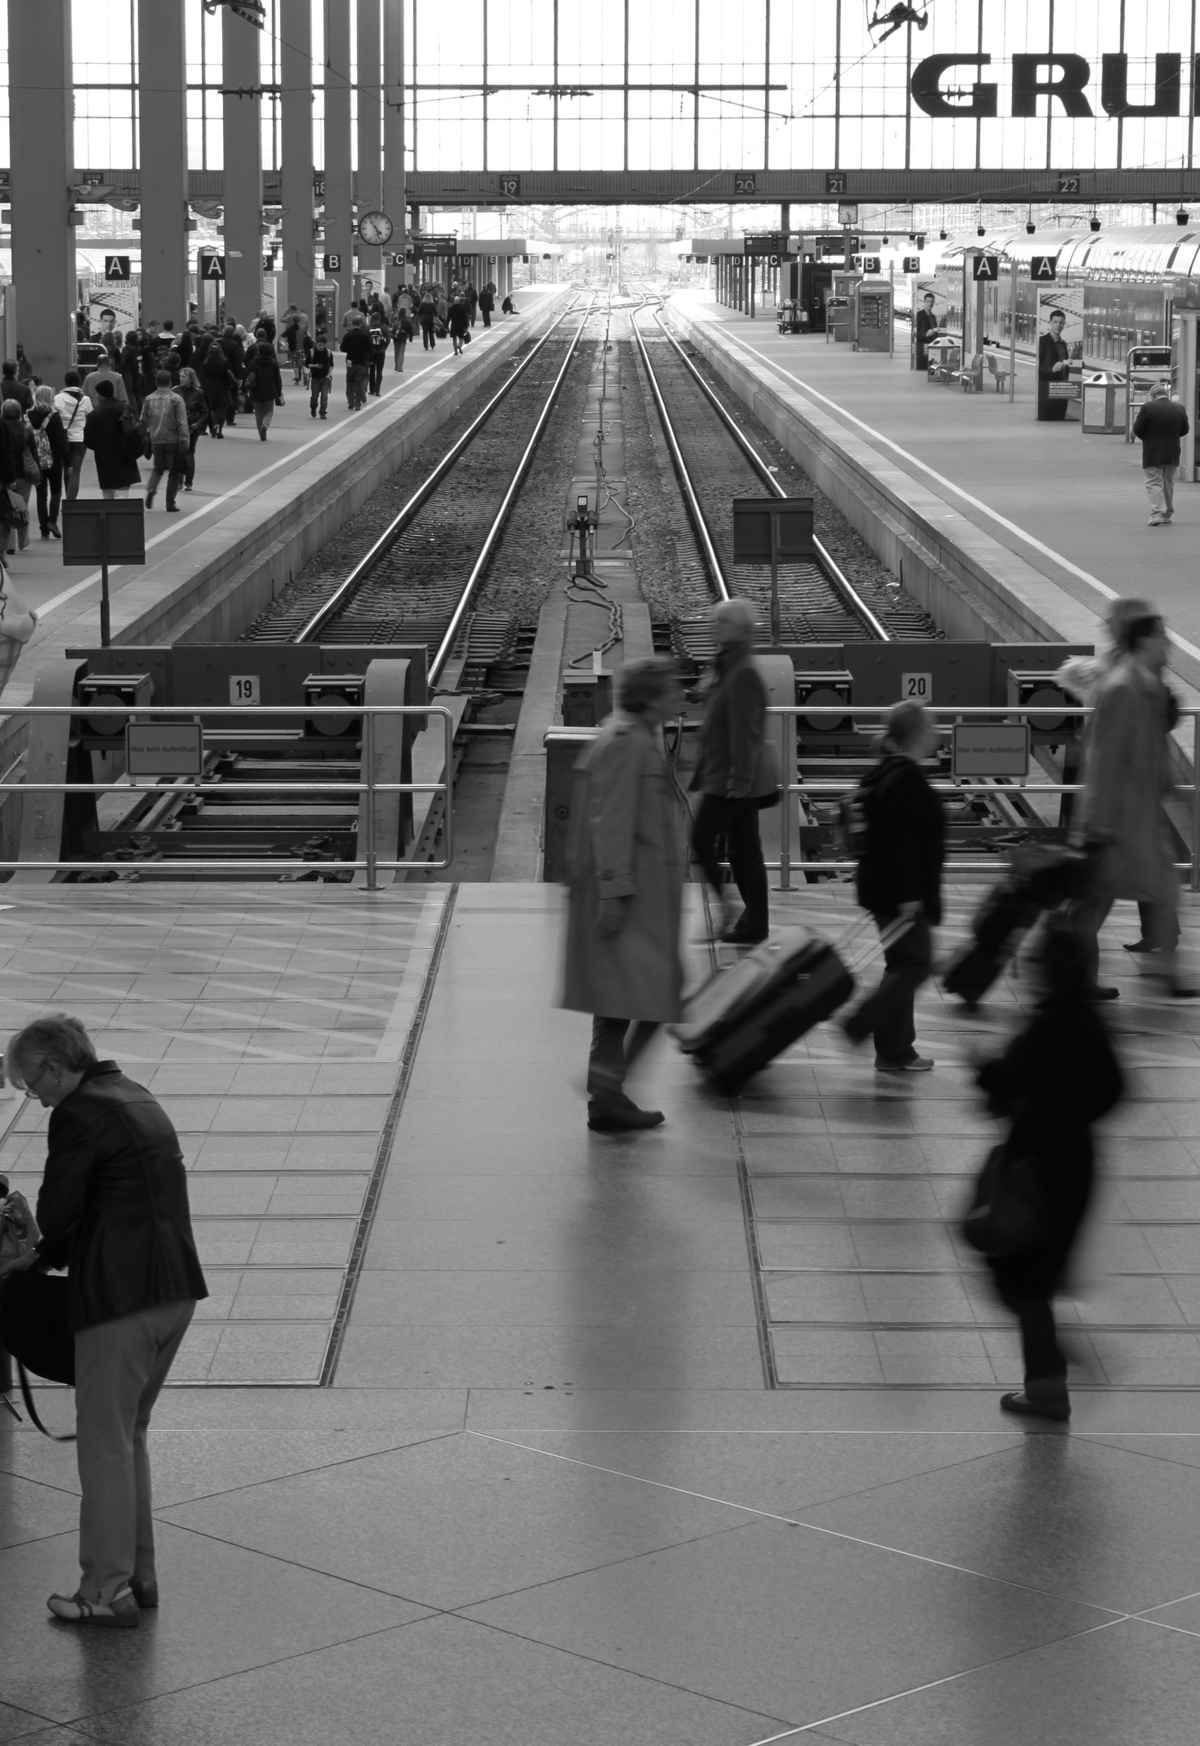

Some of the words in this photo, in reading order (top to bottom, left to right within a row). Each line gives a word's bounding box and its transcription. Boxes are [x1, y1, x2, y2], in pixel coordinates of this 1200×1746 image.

[911, 53, 1200, 117] GRU
[503, 181, 517, 193] 19
[736, 180, 754, 193] 20
[830, 180, 843, 193] 21
[108, 257, 123, 275] A
[208, 257, 222, 275] A
[329, 255, 338, 269] B
[396, 254, 404, 264] C
[770, 255, 777, 265] C
[865, 257, 874, 270] B
[909, 257, 918, 270] B
[976, 257, 992, 275] A
[1037, 257, 1052, 275] A
[236, 679, 252, 698] 19
[908, 678, 926, 696] 20
